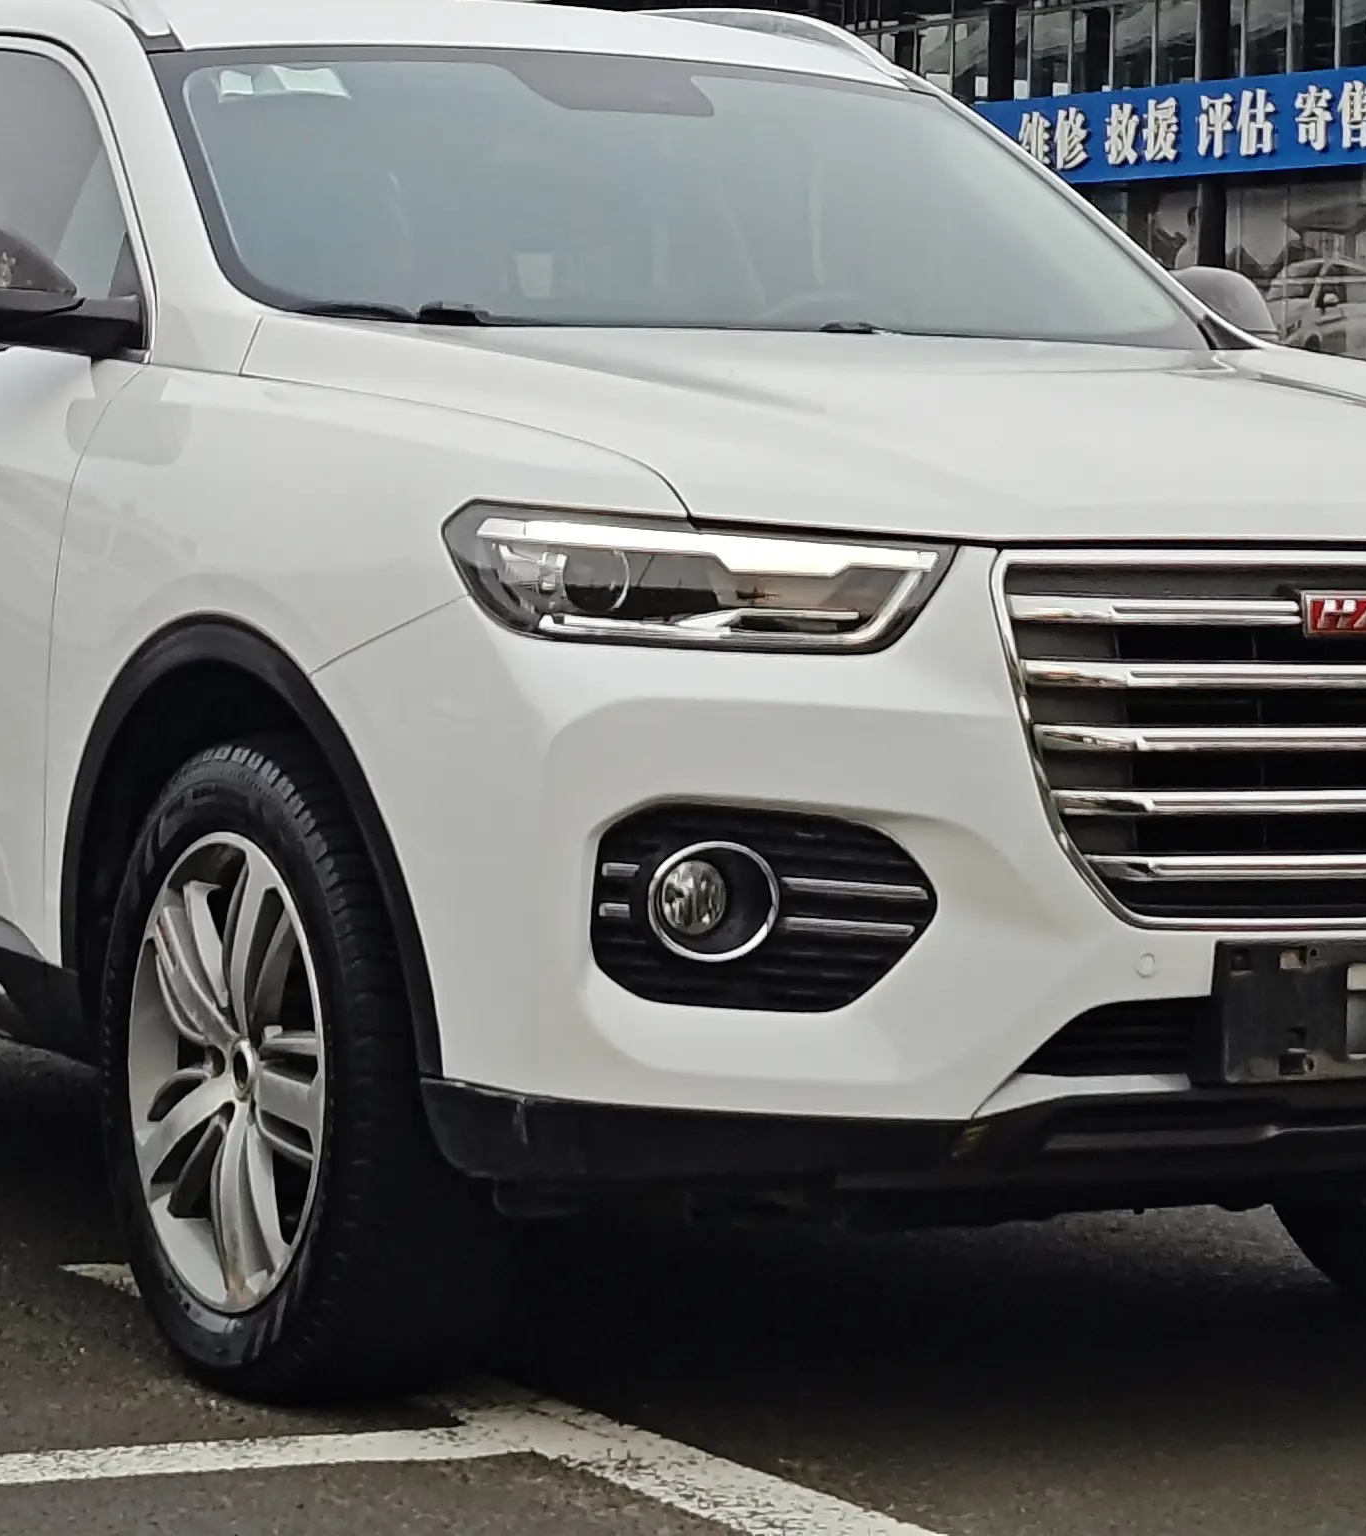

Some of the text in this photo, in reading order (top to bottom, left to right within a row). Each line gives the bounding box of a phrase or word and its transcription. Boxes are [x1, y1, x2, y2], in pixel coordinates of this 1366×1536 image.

[1017, 107, 1089, 170] 维修
[1104, 96, 1179, 164] 救援
[1196, 88, 1275, 158] 评估
